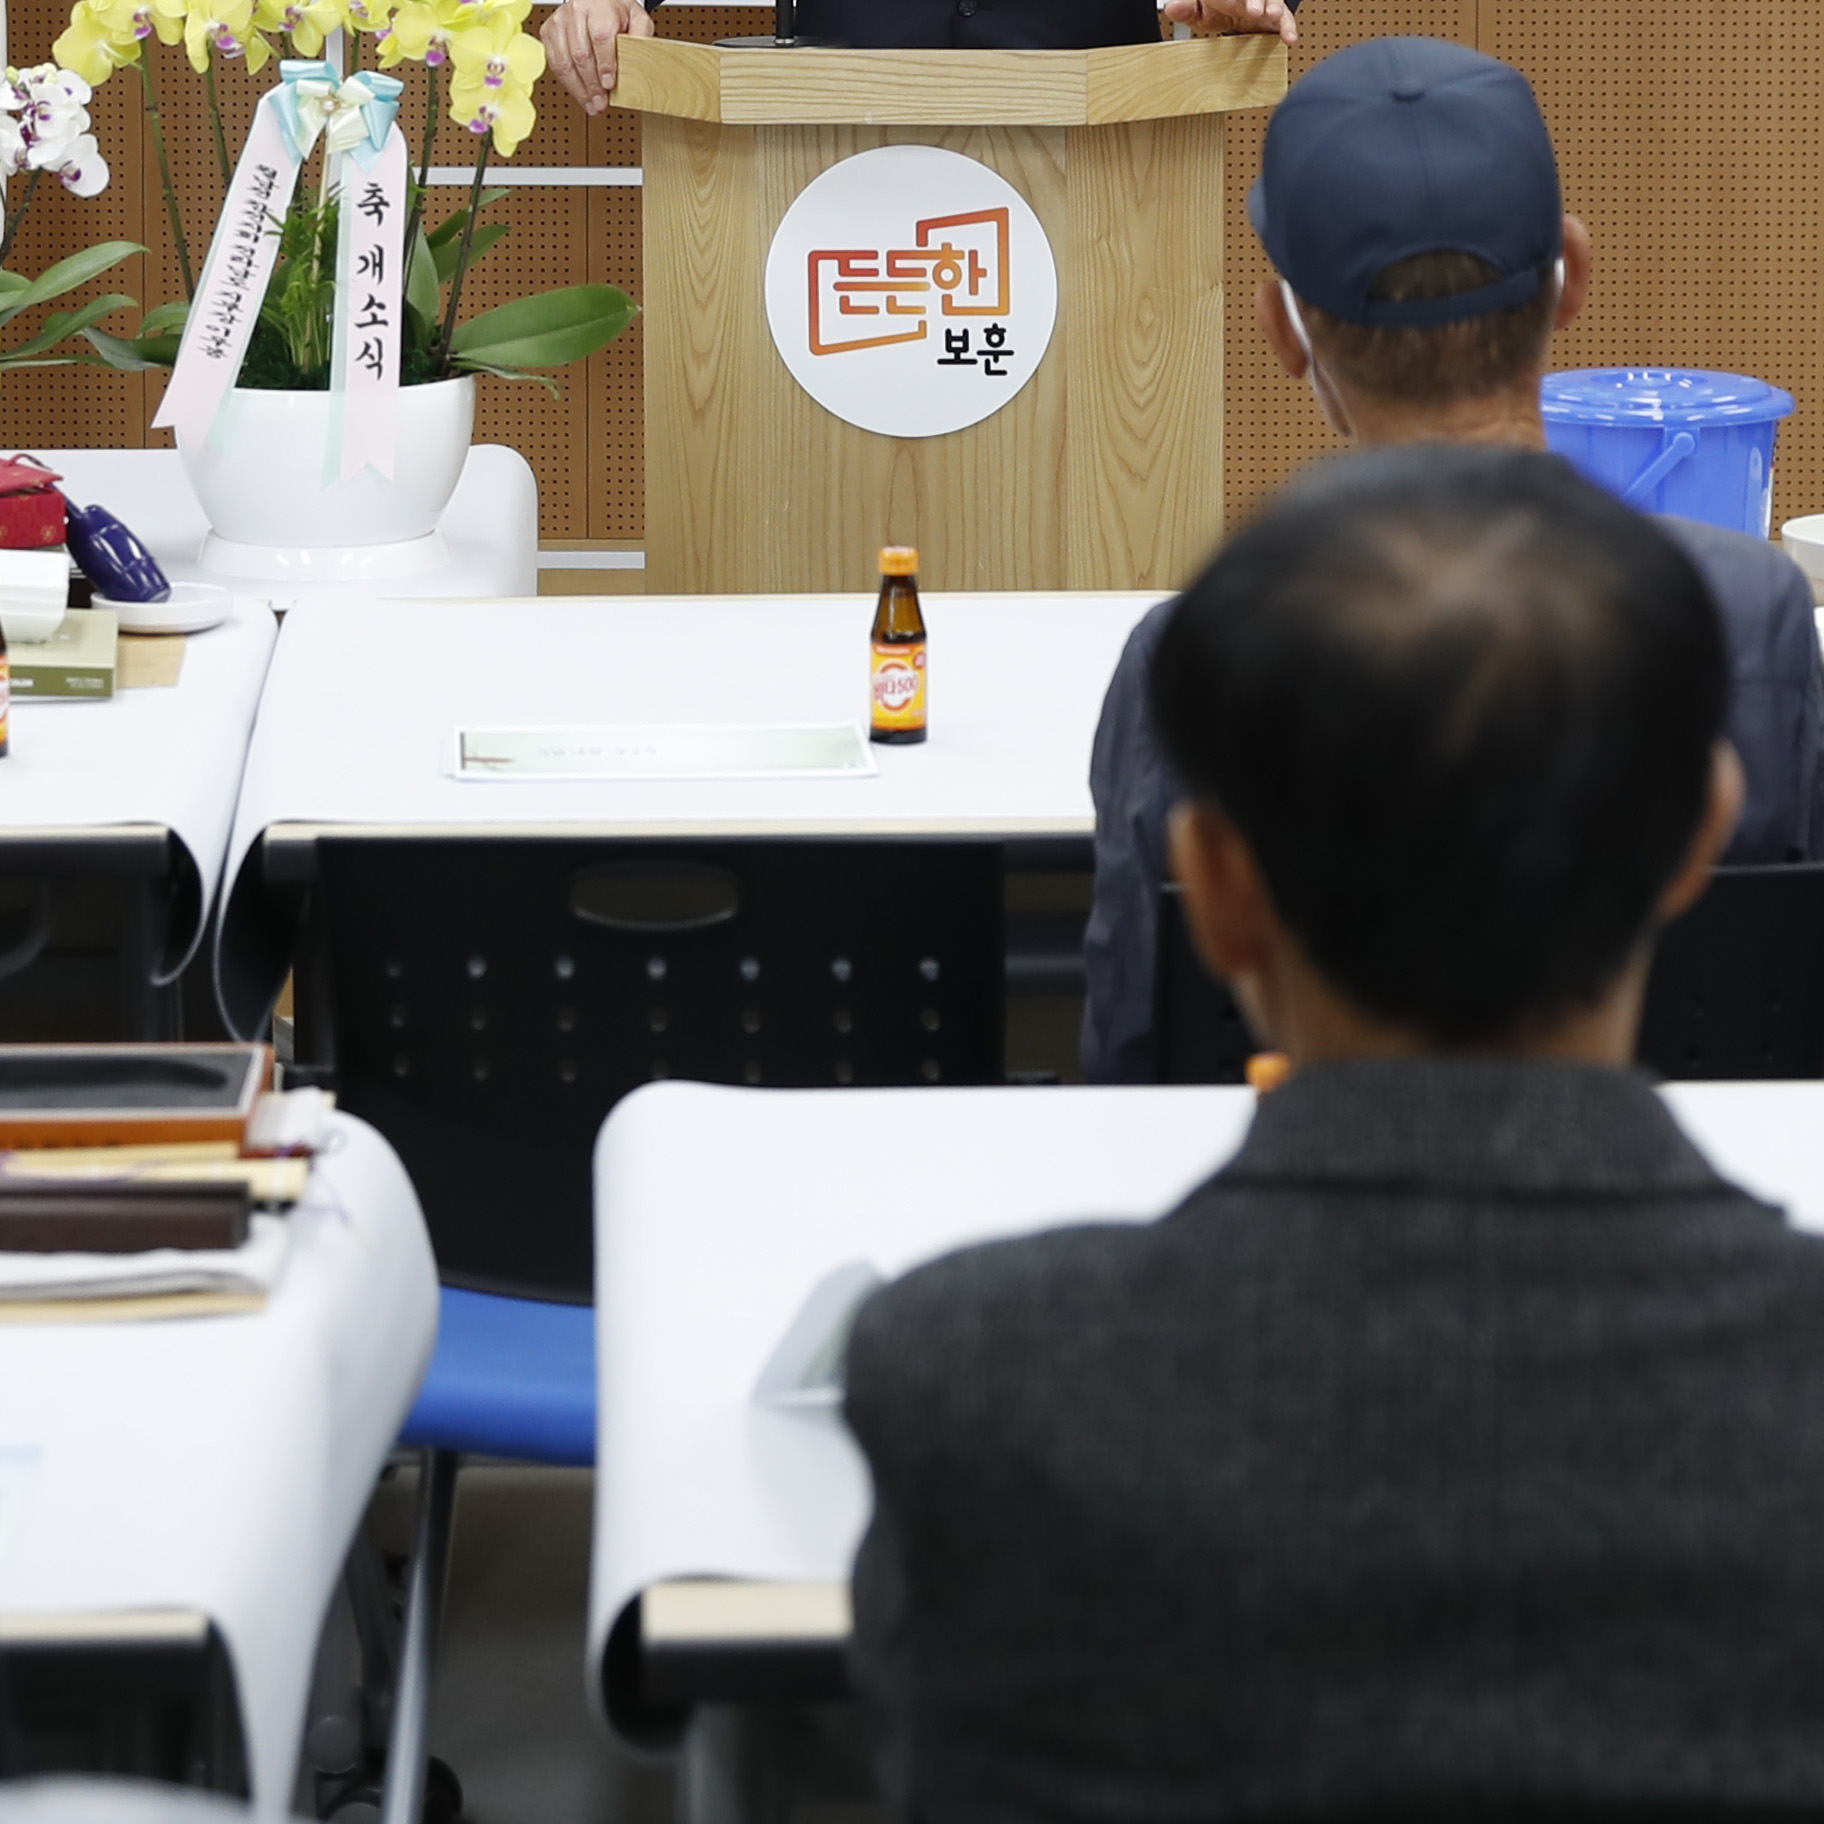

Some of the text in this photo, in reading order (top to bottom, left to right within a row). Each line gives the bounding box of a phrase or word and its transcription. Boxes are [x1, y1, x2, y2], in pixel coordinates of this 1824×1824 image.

[354, 182, 391, 382] 축 개소식
[937, 323, 1014, 376] 보훈
